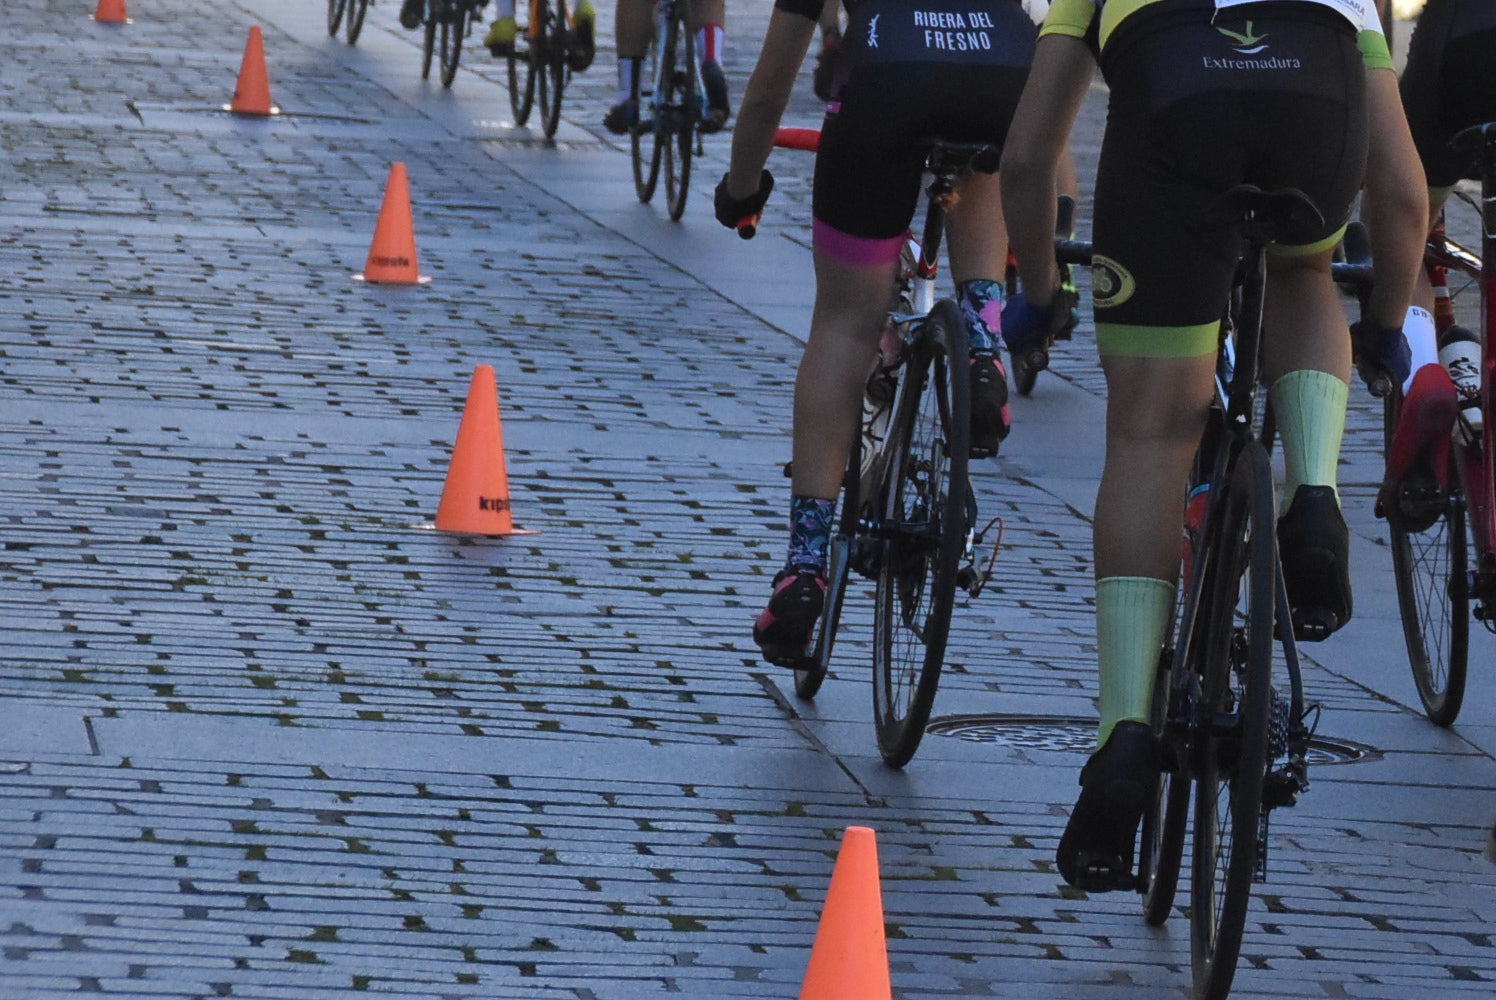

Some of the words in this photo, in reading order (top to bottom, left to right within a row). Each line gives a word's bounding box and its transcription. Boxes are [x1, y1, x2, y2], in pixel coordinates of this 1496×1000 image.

[914, 10, 965, 29] RIBERA
[969, 11, 995, 28] DEL
[924, 30, 992, 50] FRESNO
[1203, 56, 1301, 70] Extremadura
